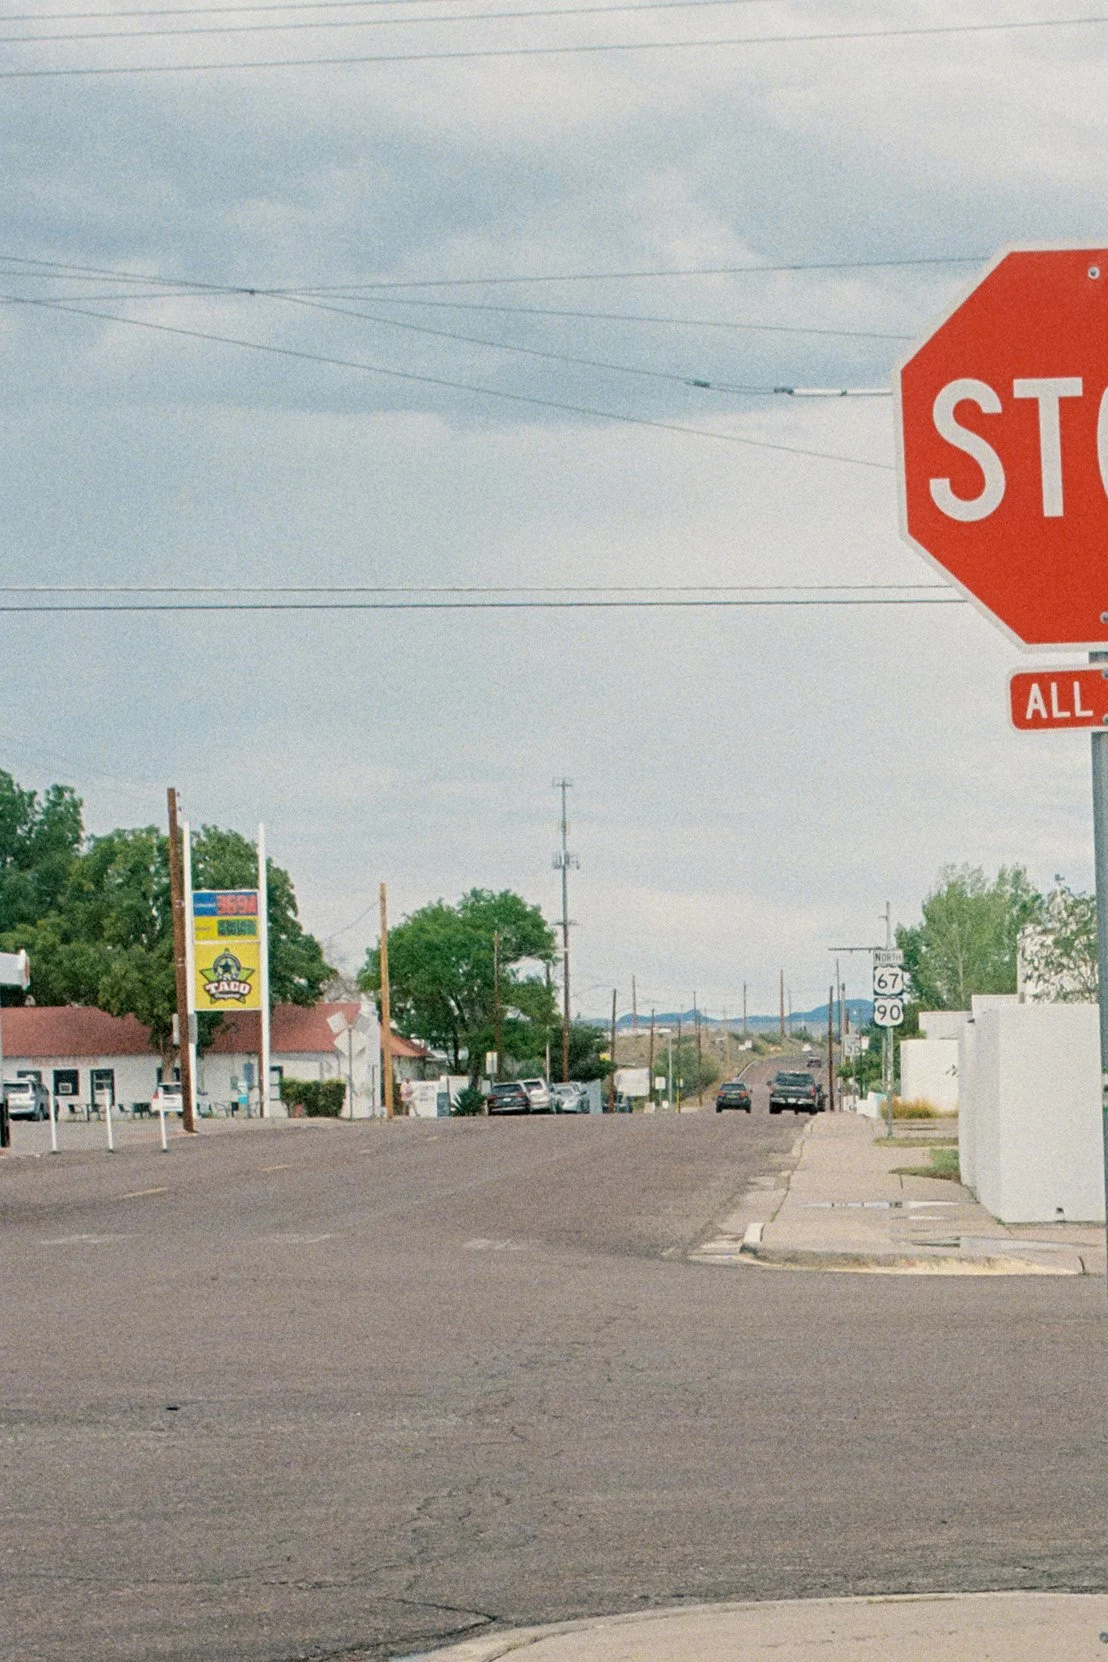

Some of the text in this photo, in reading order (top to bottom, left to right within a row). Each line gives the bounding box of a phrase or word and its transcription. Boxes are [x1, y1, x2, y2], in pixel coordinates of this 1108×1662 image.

[1025, 681, 1093, 720] ALL
[205, 981, 251, 994] TACO
[877, 973, 899, 989] 67
[876, 1005, 901, 1021] 90
